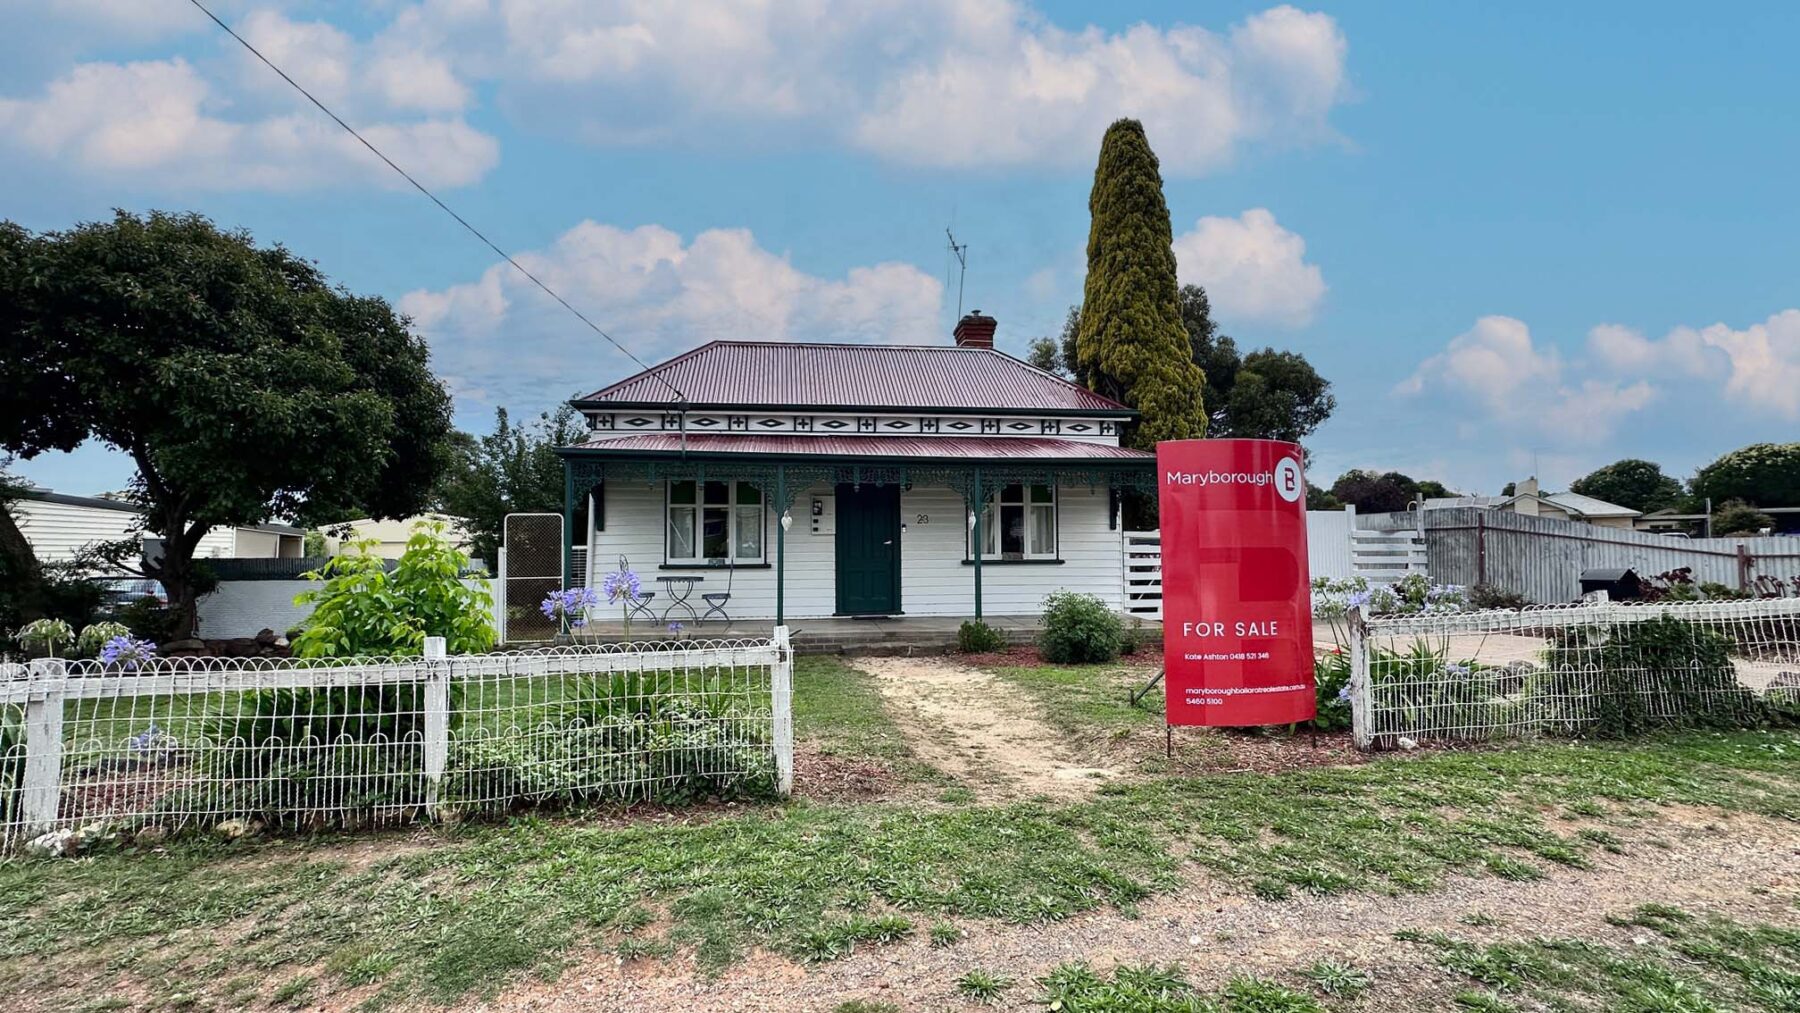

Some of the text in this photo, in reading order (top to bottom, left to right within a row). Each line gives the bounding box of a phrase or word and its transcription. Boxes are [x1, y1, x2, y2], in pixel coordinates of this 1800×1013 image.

[1166, 470, 1274, 487] Maryborough
[916, 513, 930, 525] 23
[1183, 621, 1278, 637] FOR SALE
[1184, 653, 1202, 661] Kate
[1203, 653, 1229, 661] Ashton
